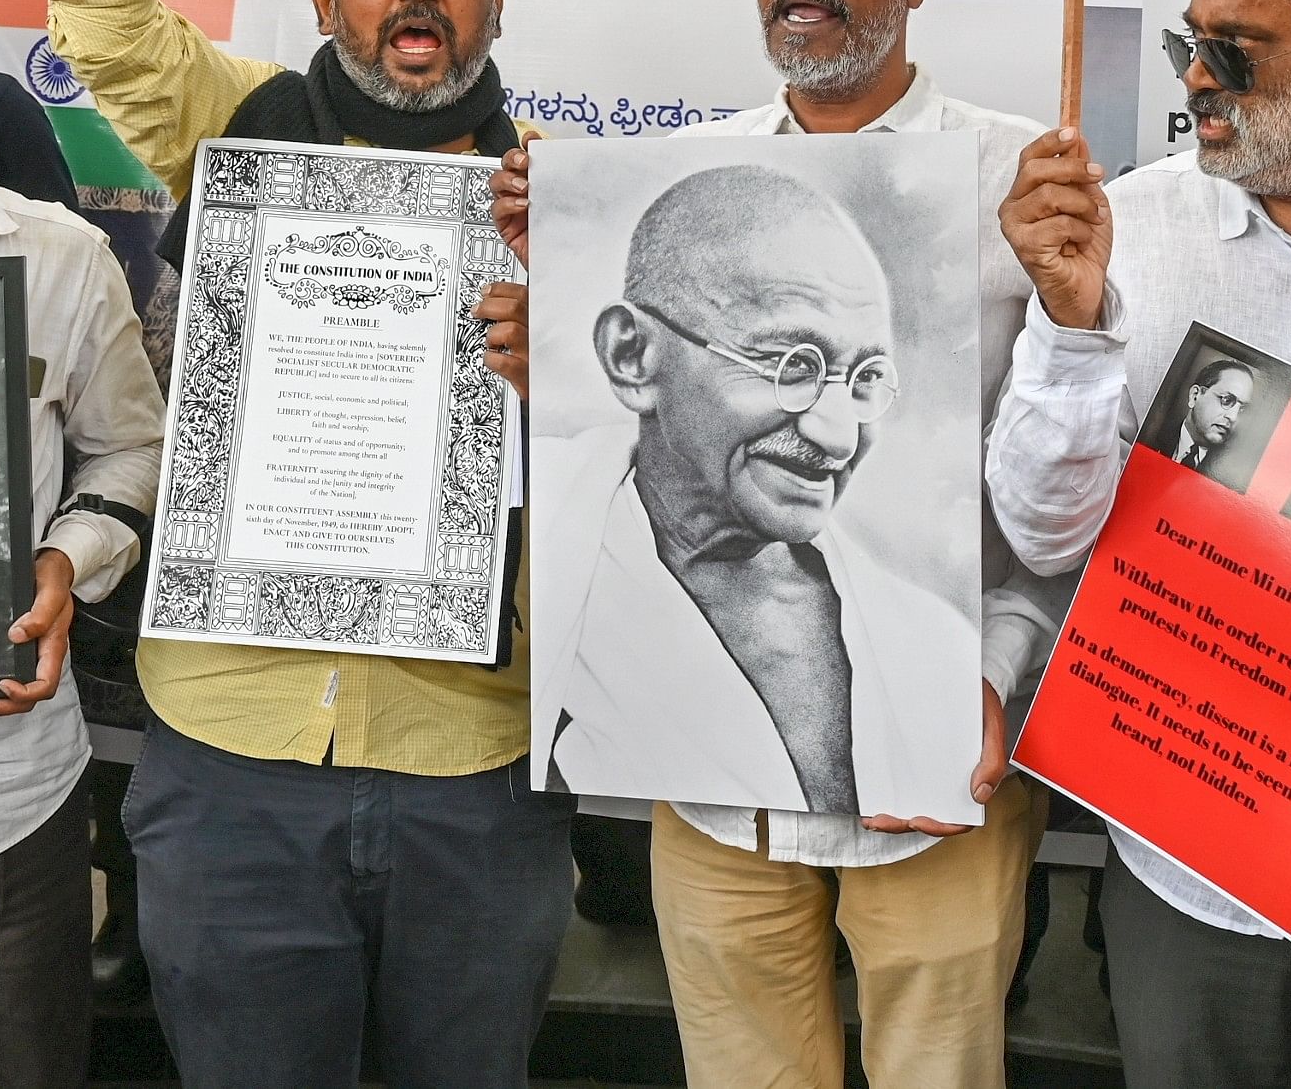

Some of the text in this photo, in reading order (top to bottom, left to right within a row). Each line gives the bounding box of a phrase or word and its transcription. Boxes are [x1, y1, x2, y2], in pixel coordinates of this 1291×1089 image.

[280, 262, 432, 281] THE CONSTITUTION OF INDIA
[323, 316, 380, 328] PREAMBLE
[1155, 517, 1197, 549] Dear
[1198, 541, 1248, 577] Home
[1113, 556, 1191, 612] Withdraw
[1196, 605, 1224, 628] the
[1226, 625, 1276, 657] order
[1119, 597, 1188, 641] protests
[1190, 633, 1208, 652] to
[1209, 642, 1286, 696] Freedom
[1067, 627, 1085, 647] In
[1087, 642, 1097, 654] a
[1100, 646, 1192, 708] democracy,
[1196, 700, 1257, 744] dissent
[1259, 734, 1274, 754] is
[1275, 749, 1286, 762] a
[1069, 660, 1141, 711] dialogue.
[1146, 701, 1159, 720] It
[1161, 715, 1210, 749] needs
[1212, 741, 1230, 761] to
[1231, 750, 1253, 773] be
[1111, 712, 1257, 812] heard, not hidden.
